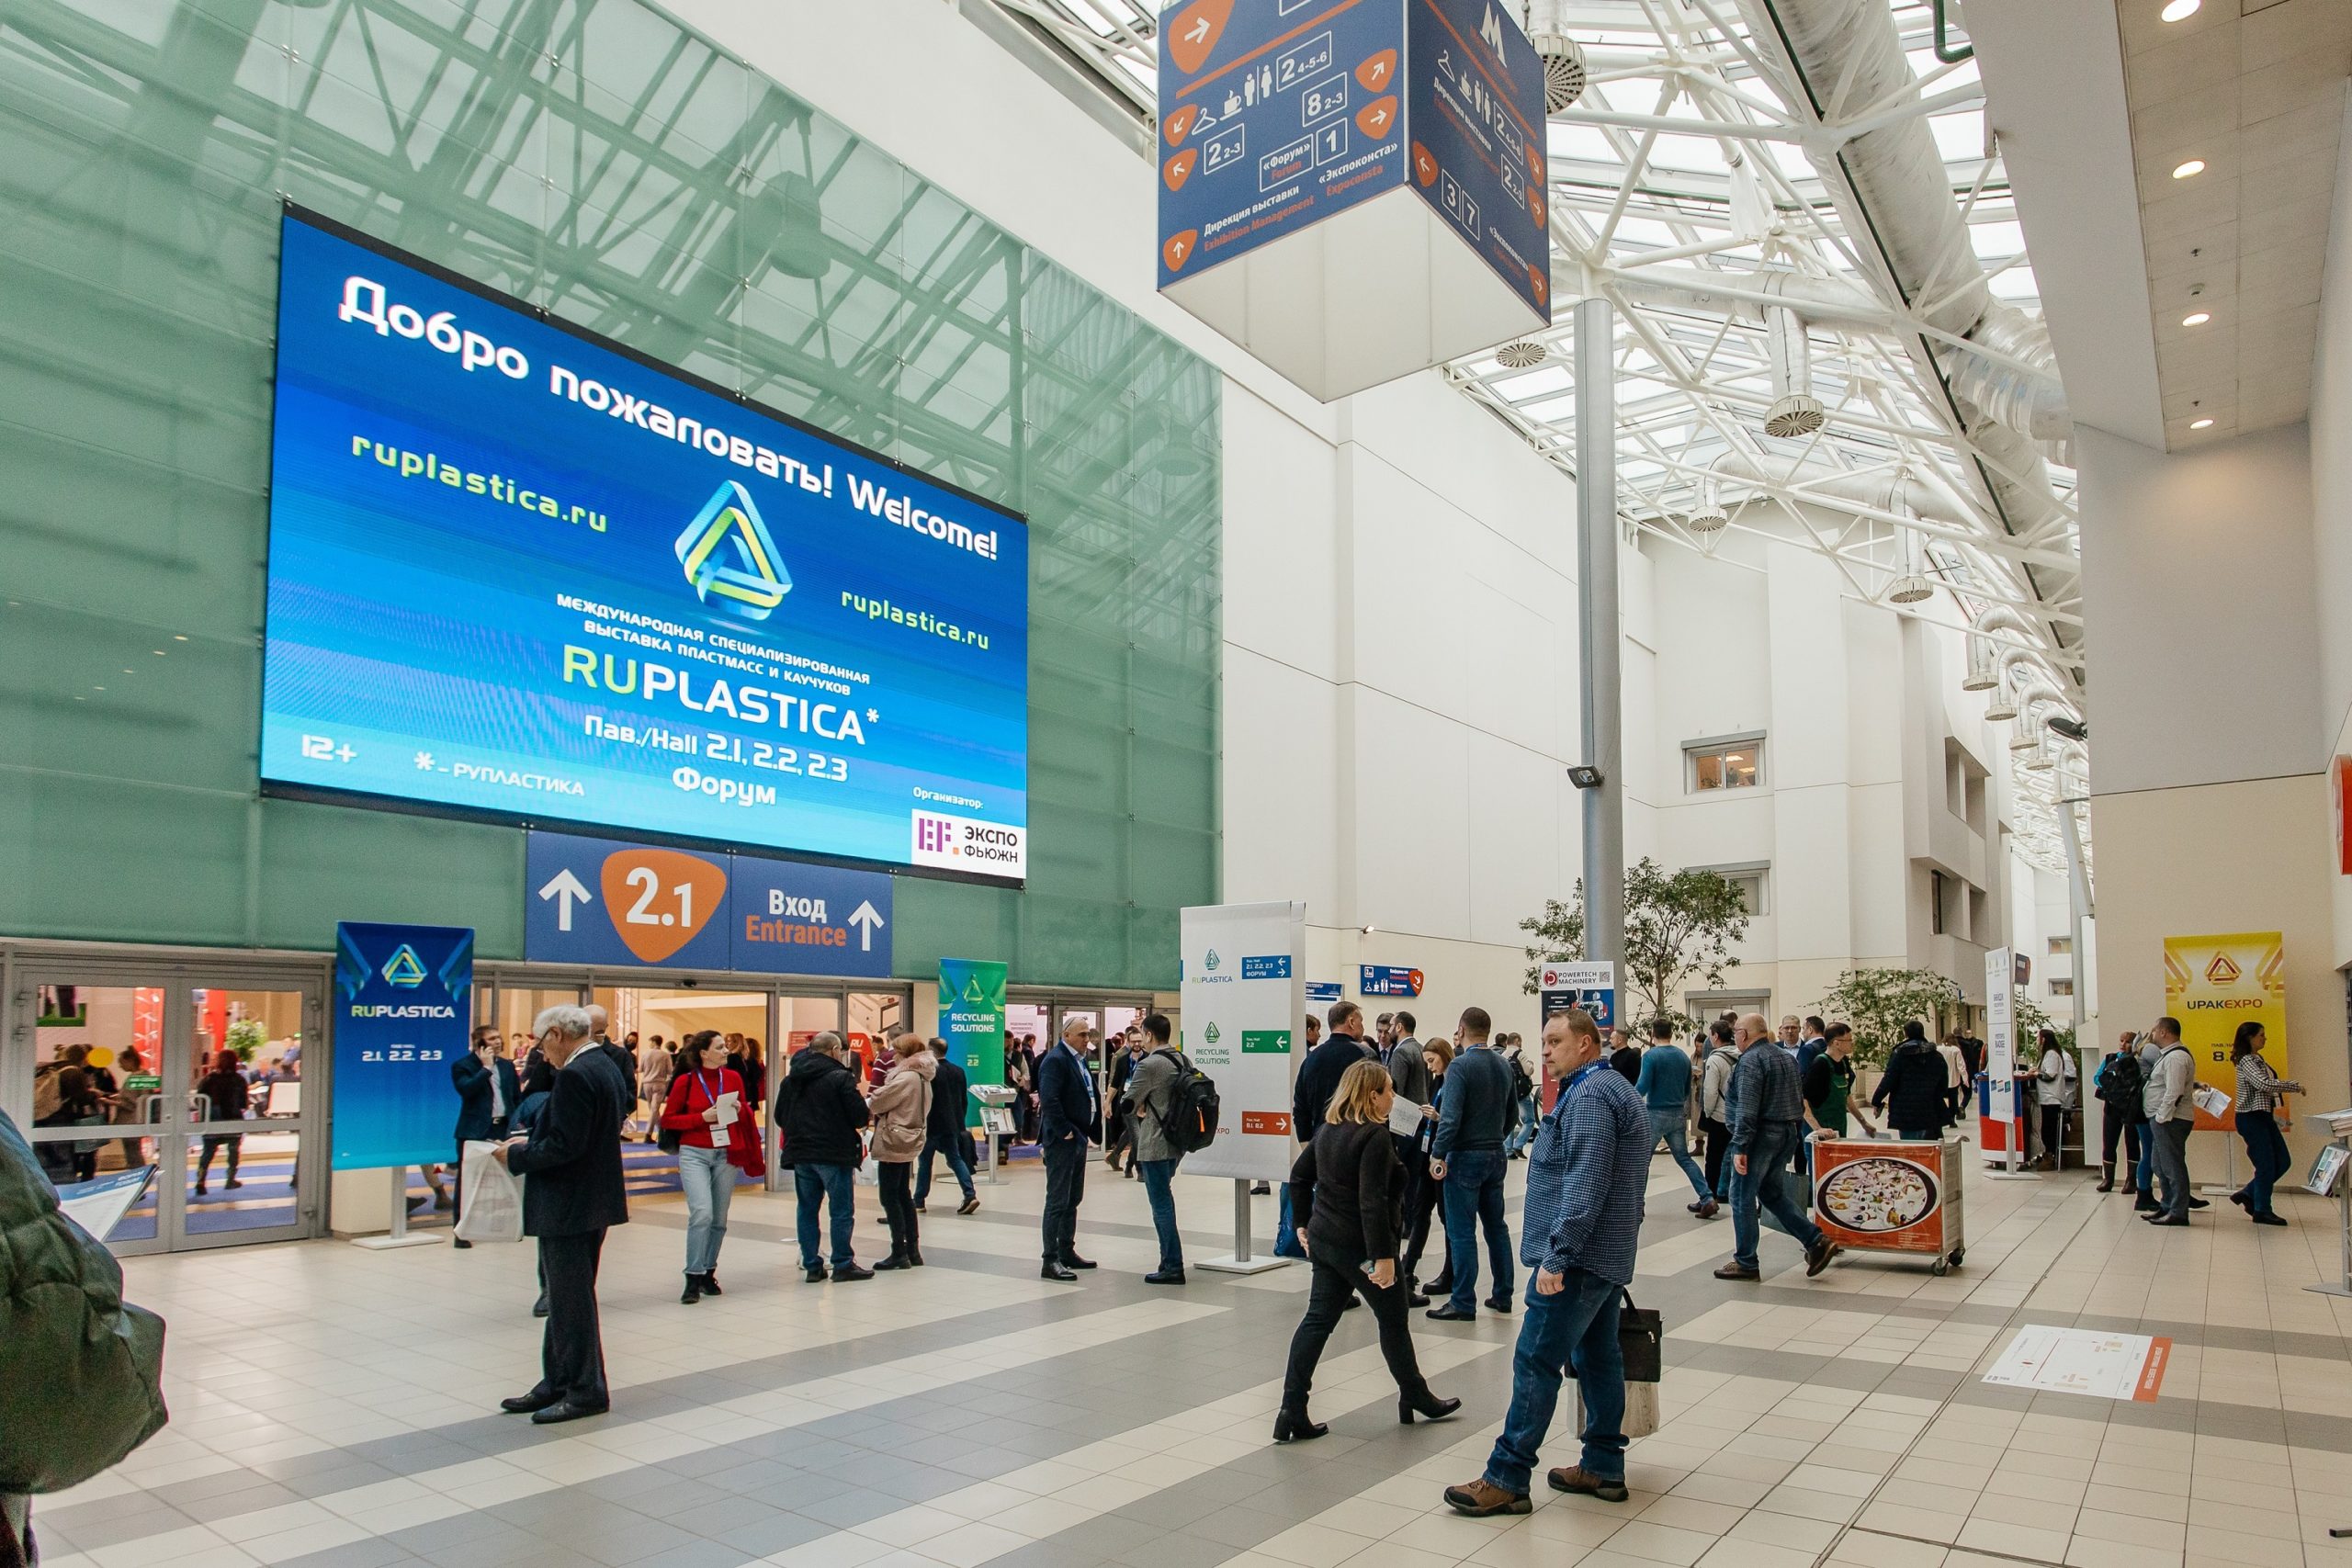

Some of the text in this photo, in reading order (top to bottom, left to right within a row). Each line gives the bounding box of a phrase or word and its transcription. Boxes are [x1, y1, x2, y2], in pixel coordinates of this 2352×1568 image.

[1282, 51, 1327, 83] 2 4-5-6
[1307, 92, 1342, 116] 8 2-3
[1208, 142, 1240, 166] 2 2-3
[1263, 143, 1310, 171] «Форум»
[1326, 130, 1337, 152] 1
[1318, 142, 1397, 185] «Экспоконста»
[1204, 185, 1299, 237] Дирекция выставки
[1447, 183, 1476, 226] 3 7
[1204, 195, 1315, 252] Exhibition Management
[339, 276, 998, 560] Добро пожаловать! Welcome!
[352, 434, 607, 533] ruplastica.ru
[841, 591, 989, 650] ruplastica.ru
[557, 593, 870, 684] МЕЖДУНАРОДНАЯ СПЕЦИАЛИЗИРОВАННАЯ
[584, 620, 851, 697] ВЫСТАВКА ПЛАСТМАСС И КАУЧУКОВ
[301, 734, 358, 763] 12+
[585, 715, 698, 755] Пав./Hall
[753, 745, 803, 777] 2.2,
[808, 755, 849, 783] 2.3
[453, 762, 585, 797] РУПЛАСТИКА
[673, 766, 776, 807] Форум
[913, 786, 984, 809] Организатор:
[965, 825, 1018, 847] ЭКСПО
[965, 844, 1018, 863] ФЬЮЖН
[626, 866, 692, 928] 2.1
[768, 888, 828, 924] Вход
[746, 915, 847, 948] Entrance
[1192, 976, 1233, 984] RUPLASTICA
[351, 1005, 456, 1019] RUPLASTICA
[951, 1013, 995, 1022] RECYCLING
[2187, 998, 2263, 1010] UPAKEXPO
[951, 1023, 995, 1032] SOLUTIONS
[420, 1049, 443, 1061] 2.3
[967, 1058, 979, 1066] 2.2
